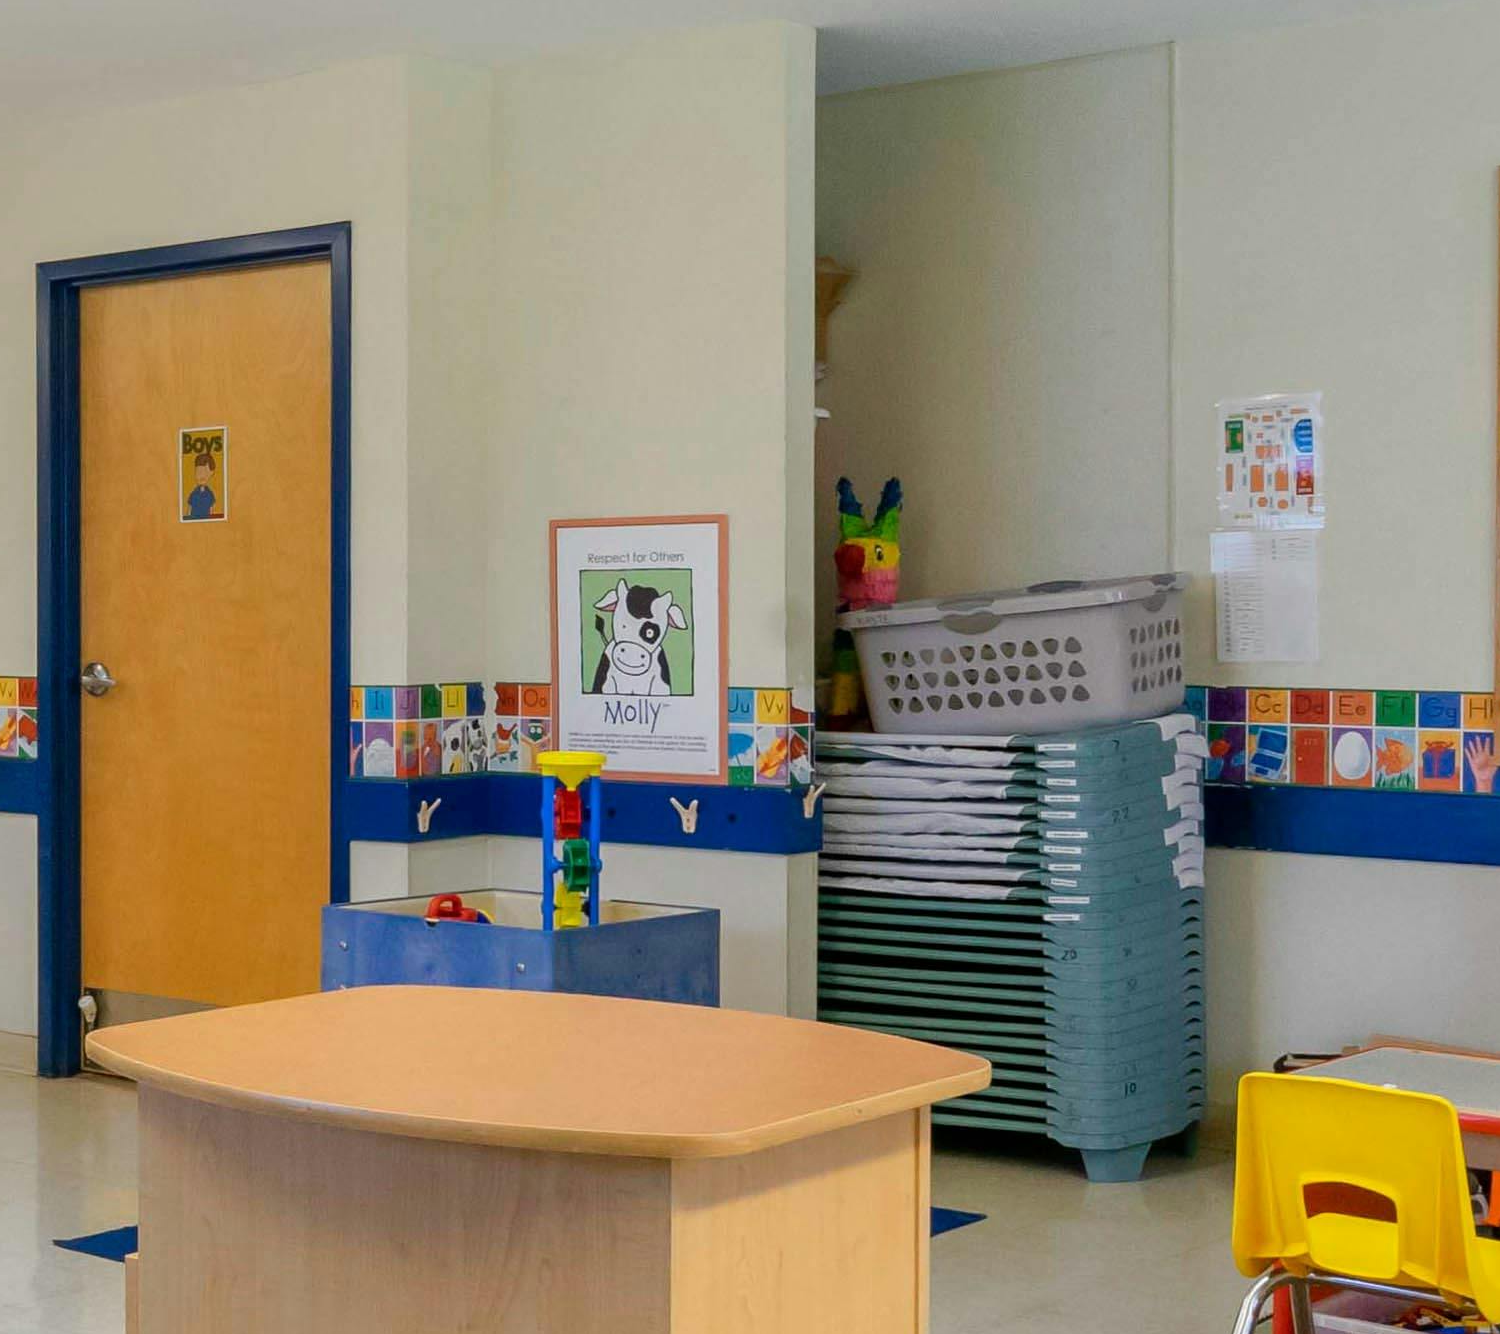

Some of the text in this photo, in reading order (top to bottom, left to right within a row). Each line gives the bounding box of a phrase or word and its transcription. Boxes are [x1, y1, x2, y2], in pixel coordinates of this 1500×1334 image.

[182, 433, 223, 455] Boys
[587, 550, 685, 565] Respect for Others
[523, 689, 548, 709] Oo
[762, 693, 784, 714] Vv
[1254, 693, 1282, 715] Cc
[1295, 694, 1325, 717] Dd
[1338, 695, 1367, 717] Ee
[1423, 696, 1457, 727] Gg
[604, 698, 664, 734] Molly
[1060, 949, 1078, 962] 20
[1123, 1082, 1138, 1099] 10
